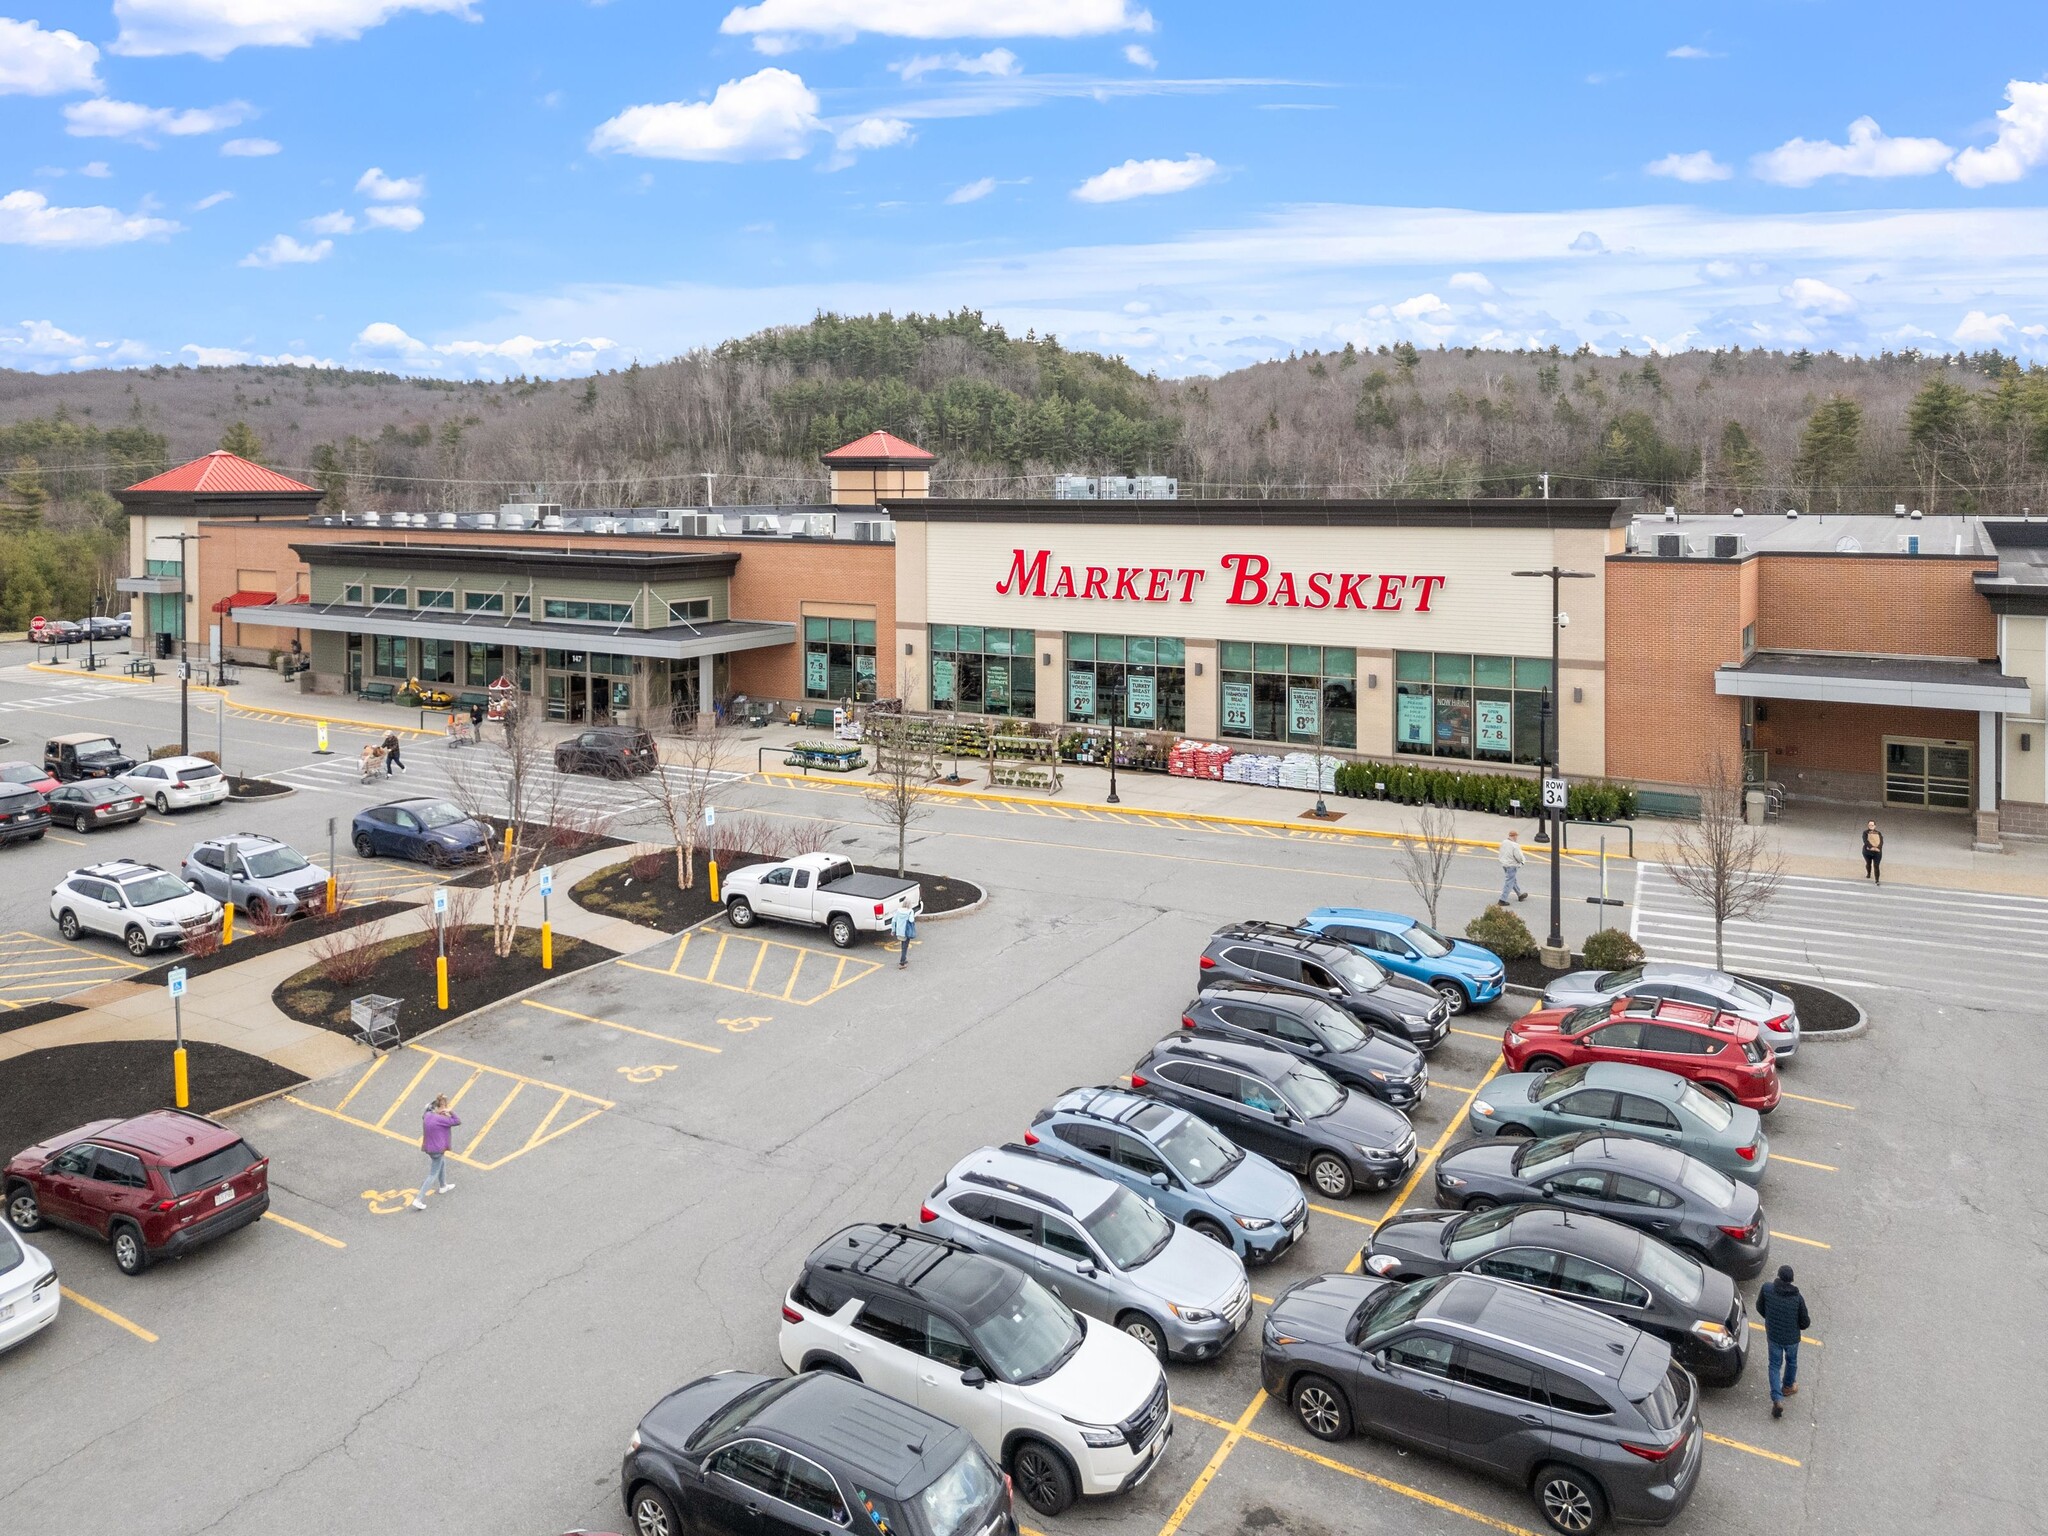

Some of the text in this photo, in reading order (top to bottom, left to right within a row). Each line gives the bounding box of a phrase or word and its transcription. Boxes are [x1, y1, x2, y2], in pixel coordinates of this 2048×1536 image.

[995, 548, 1447, 613] MARKET BASKET
[1451, 699, 1470, 708] HIRING
[1545, 780, 1564, 790] ROW
[1288, 831, 1357, 843] FIRE
